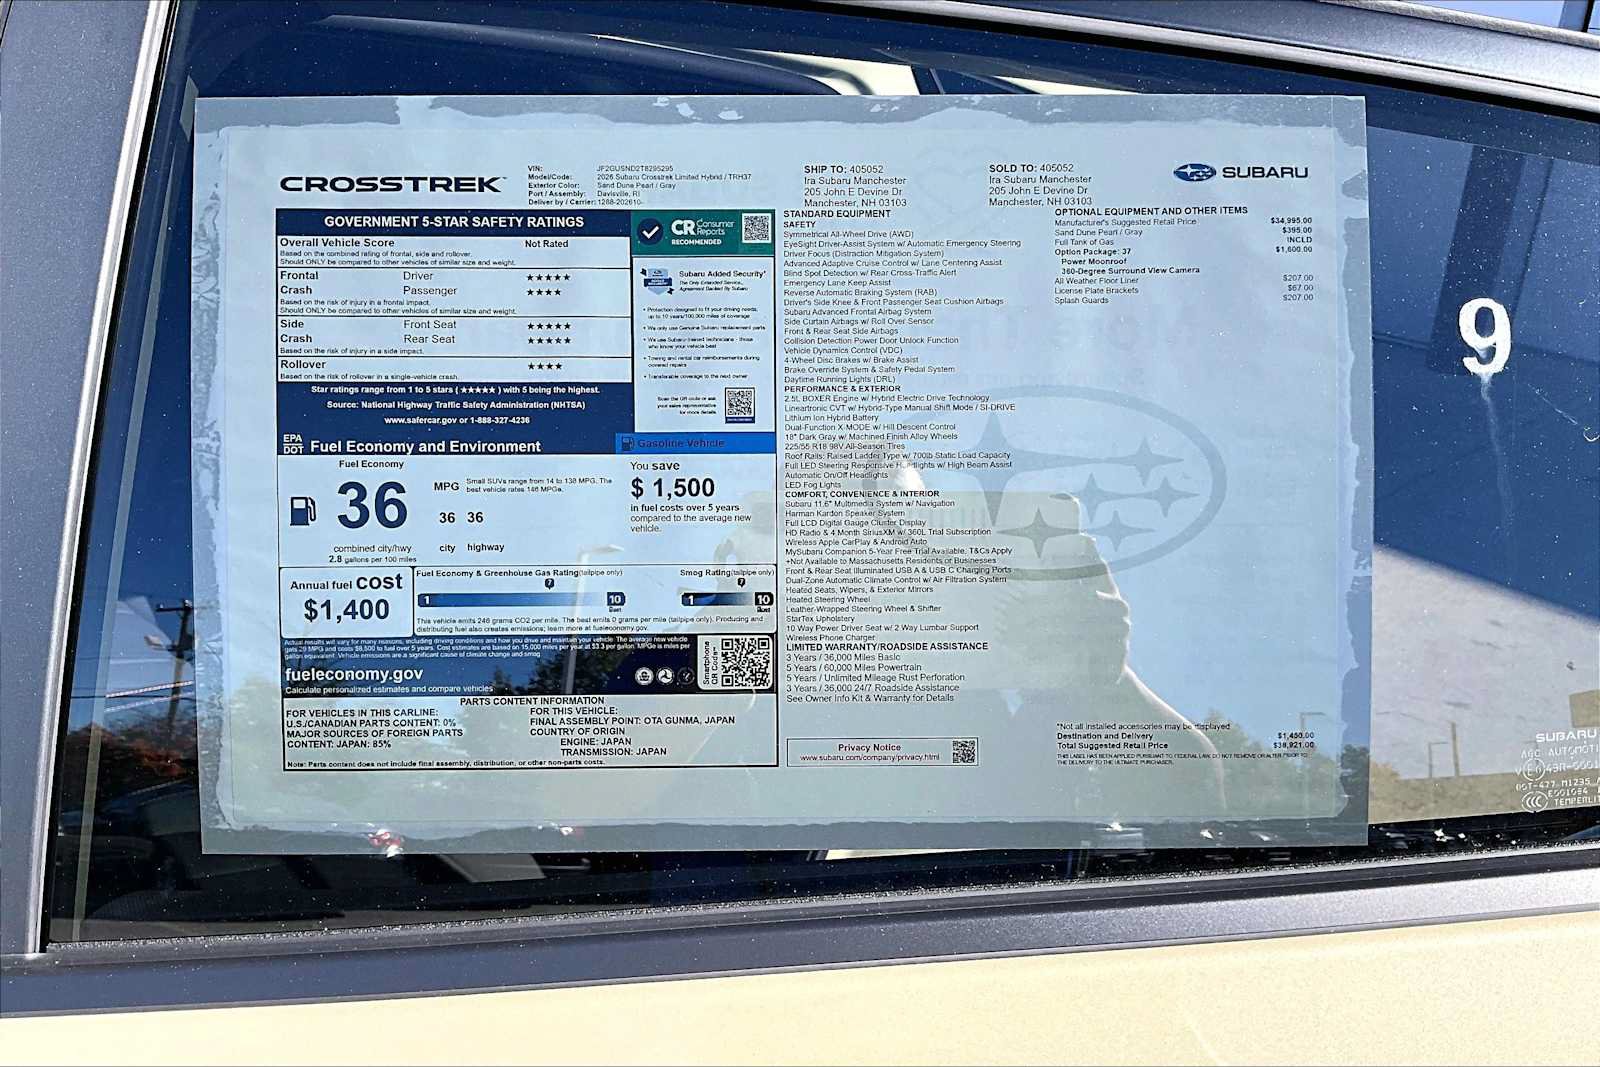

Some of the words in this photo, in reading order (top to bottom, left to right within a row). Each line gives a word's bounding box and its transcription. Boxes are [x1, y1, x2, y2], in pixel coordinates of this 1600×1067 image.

[804, 165, 828, 174] SHIP
[830, 165, 847, 174] TO:
[849, 165, 883, 174] 405052
[989, 164, 1017, 173] SOLD
[1020, 164, 1037, 172] TO:
[1040, 163, 1074, 172] 405052
[1222, 166, 1308, 178] SUBARU
[804, 177, 816, 185] Ira
[818, 176, 851, 185] Subaru
[853, 176, 907, 185] Manchester
[989, 176, 1001, 184] Ira
[1003, 175, 1036, 184] Subaru
[1039, 175, 1092, 183] Manchester
[280, 176, 501, 193] CROSSTREK
[804, 187, 821, 196] 205
[823, 188, 846, 196] John
[848, 187, 855, 196] E
[857, 187, 889, 196] Devine
[891, 187, 902, 196] Dr
[989, 186, 1006, 195] 205
[1008, 186, 1031, 195] John
[1033, 186, 1040, 195] E
[1043, 186, 1075, 195] Devine
[1077, 186, 1088, 194] Dr
[804, 199, 859, 207] Manchester,
[861, 198, 876, 207] NH
[878, 198, 907, 207] 03103
[989, 198, 1044, 206] Manchester,
[1047, 197, 1062, 206] NH
[1064, 197, 1092, 206] 03103
[783, 210, 834, 218] STANDARD
[836, 209, 891, 218] EQUIPMENT
[1055, 208, 1102, 216] OPTIONAL
[1104, 207, 1160, 216] EQUIPMENT
[1161, 207, 1182, 215] AND
[1184, 206, 1217, 215] OTHER
[1220, 206, 1248, 214] ITEMS
[324, 216, 419, 227] GOVERNMENT
[422, 216, 469, 227] 5-STAR
[472, 216, 524, 227] SAFETY
[527, 216, 584, 227] RATINGS
[696, 219, 735, 228] Consumer
[671, 220, 696, 235] CR
[697, 228, 725, 236] Reports
[280, 238, 318, 247] Overall
[321, 238, 360, 247] Vehicle
[364, 238, 395, 247] Score
[525, 240, 541, 248] Not
[543, 239, 569, 248] Rated
[1083, 248, 1120, 256] Package:
[280, 270, 319, 280] Frontal
[403, 271, 433, 280] Driver
[280, 285, 312, 294] Crash
[403, 285, 457, 297] Passenger
[280, 319, 304, 328] Side
[404, 320, 430, 329] Front
[433, 320, 456, 329] Seat
[280, 334, 312, 343] Crash
[404, 334, 429, 343] Rear
[431, 334, 455, 344] Seat
[1458, 297, 1512, 376] 9
[280, 359, 326, 369] Rollover
[397, 401, 433, 410] Highway
[462, 401, 488, 410] Safety
[551, 401, 585, 410] (NHTSA)
[384, 417, 457, 425] www.safercar.gov
[470, 416, 530, 424] 1-888-327-4236
[283, 434, 303, 442] EPA
[311, 440, 341, 452] Fuel
[346, 440, 414, 455] Economy
[418, 441, 445, 452] and
[450, 440, 541, 452] Environment
[637, 439, 684, 448] Gasoline
[685, 438, 725, 448] Vehicle
[283, 444, 304, 454] DOT
[339, 460, 359, 468] Fuel
[361, 460, 404, 469] Economy
[630, 462, 649, 470] You
[652, 462, 680, 471] save
[434, 482, 459, 491] MPG
[631, 477, 644, 500] $
[653, 478, 715, 500] 1,500
[338, 481, 407, 529] 36
[439, 512, 455, 523] 36
[467, 511, 484, 523] 36
[333, 545, 375, 553] combined
[377, 544, 412, 554] city/hwy
[439, 545, 456, 553] city
[467, 543, 505, 553] highway
[290, 581, 329, 590] Annual
[332, 581, 352, 589] fuel
[356, 574, 403, 590] cost
[304, 598, 389, 623] $1,400
[786, 643, 823, 651] LIMITED
[824, 641, 928, 651] WARRANTY/ROADSIDE
[930, 642, 988, 650] ASSISTANCE
[285, 668, 423, 683] fueleconomy.gov
[460, 697, 491, 706] PARTS
[493, 697, 538, 706] CONTENT
[540, 696, 605, 705] INFORMATION
[530, 707, 550, 715] FOR
[552, 707, 573, 715] THIS
[575, 706, 618, 715] VEHICLE:
[530, 717, 557, 726] FINAL
[559, 717, 610, 725] ASSEMBLY
[611, 717, 641, 725] POINT:
[644, 716, 663, 724] OTA
[704, 716, 735, 724] JAPAN
[530, 727, 575, 736] COUNTRY
[577, 727, 591, 735] OF
[592, 727, 625, 735] ORIGIN
[1057, 732, 1102, 740] Destination
[1121, 732, 1154, 740] Delivery
[1536, 729, 1597, 742] SUBARU
[560, 738, 599, 746] ENGINE:
[601, 737, 632, 745] JAPAN
[838, 744, 871, 752] Privacy
[873, 743, 901, 751] Notice
[1078, 742, 1121, 751] Suggested
[560, 748, 633, 756] TRANSMISSION:
[636, 747, 667, 755] JAPAN
